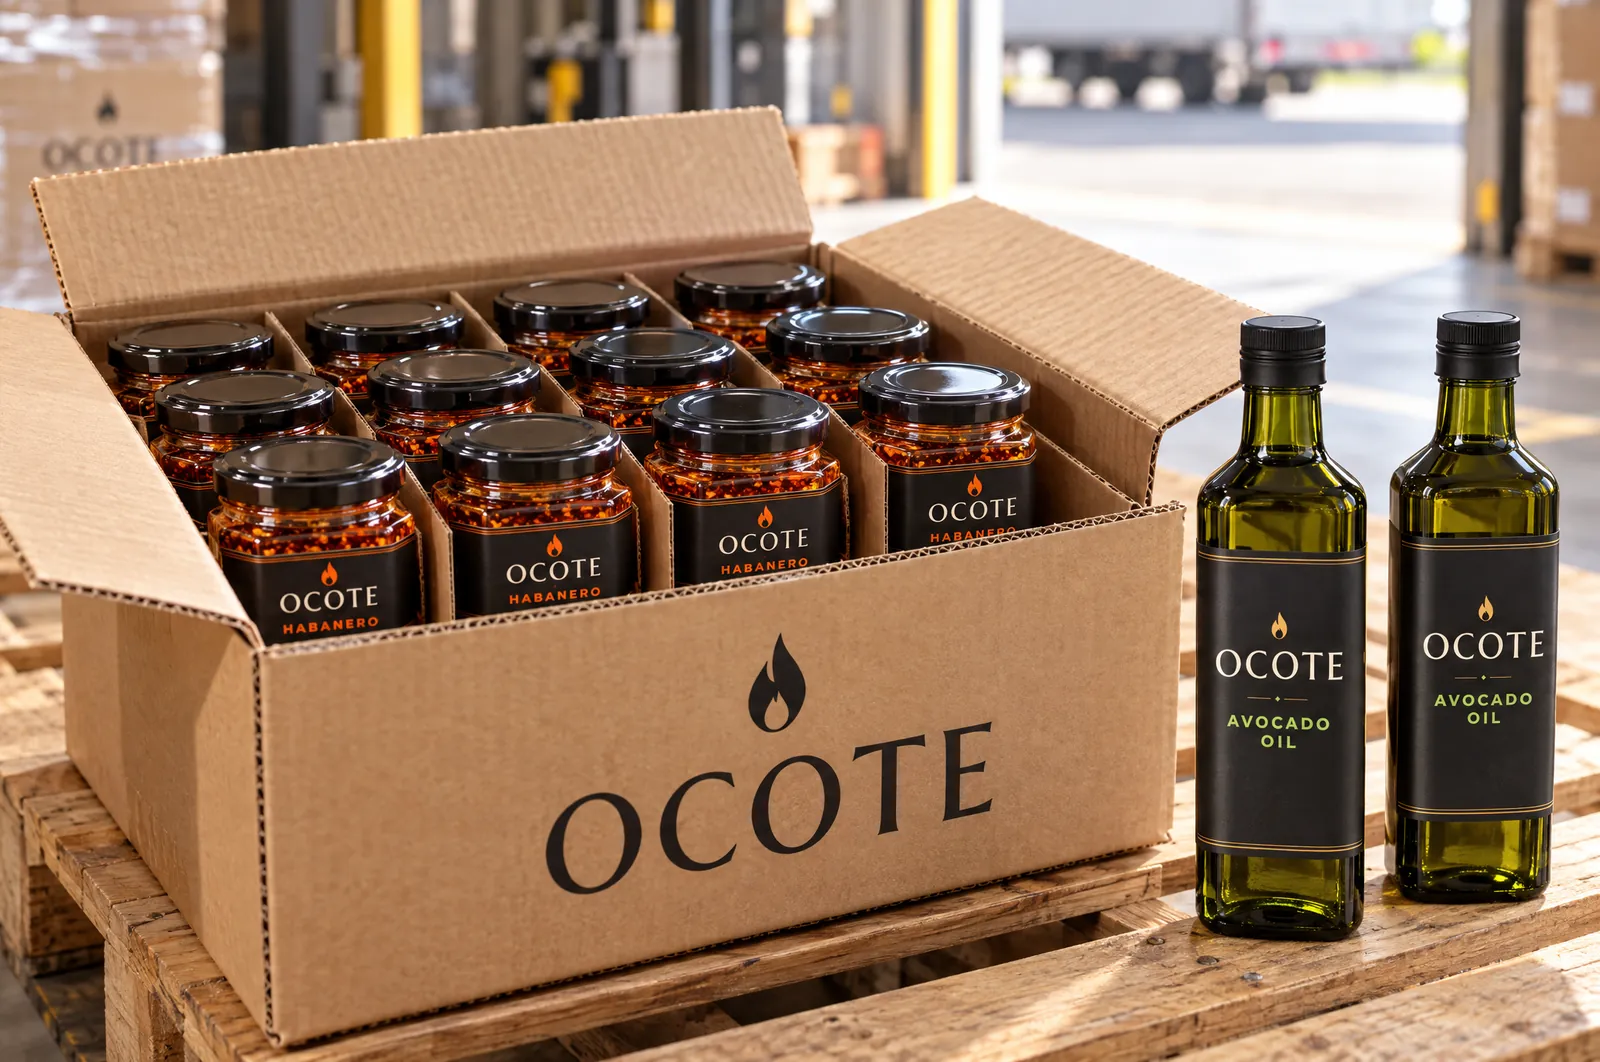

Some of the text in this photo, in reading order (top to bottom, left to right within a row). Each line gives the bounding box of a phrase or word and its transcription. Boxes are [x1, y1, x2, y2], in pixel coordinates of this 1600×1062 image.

[928, 497, 1018, 523] OCOTE
[718, 528, 810, 555] OCOTE
[930, 526, 1016, 543] HABANERO
[506, 556, 602, 585] OCOTE
[721, 557, 808, 575] HABANERO
[280, 585, 379, 614] OCOTE
[509, 587, 602, 605] HABANERO
[282, 616, 380, 635] HABANERO
[1422, 629, 1545, 661] OCOTE
[1215, 648, 1344, 681] OCOTE
[1434, 692, 1533, 707] AVOCADO
[1227, 714, 1331, 731] AVOCADO
[1467, 711, 1501, 725] OIL
[1260, 734, 1297, 749] OIL
[546, 721, 993, 895] OCOTE
